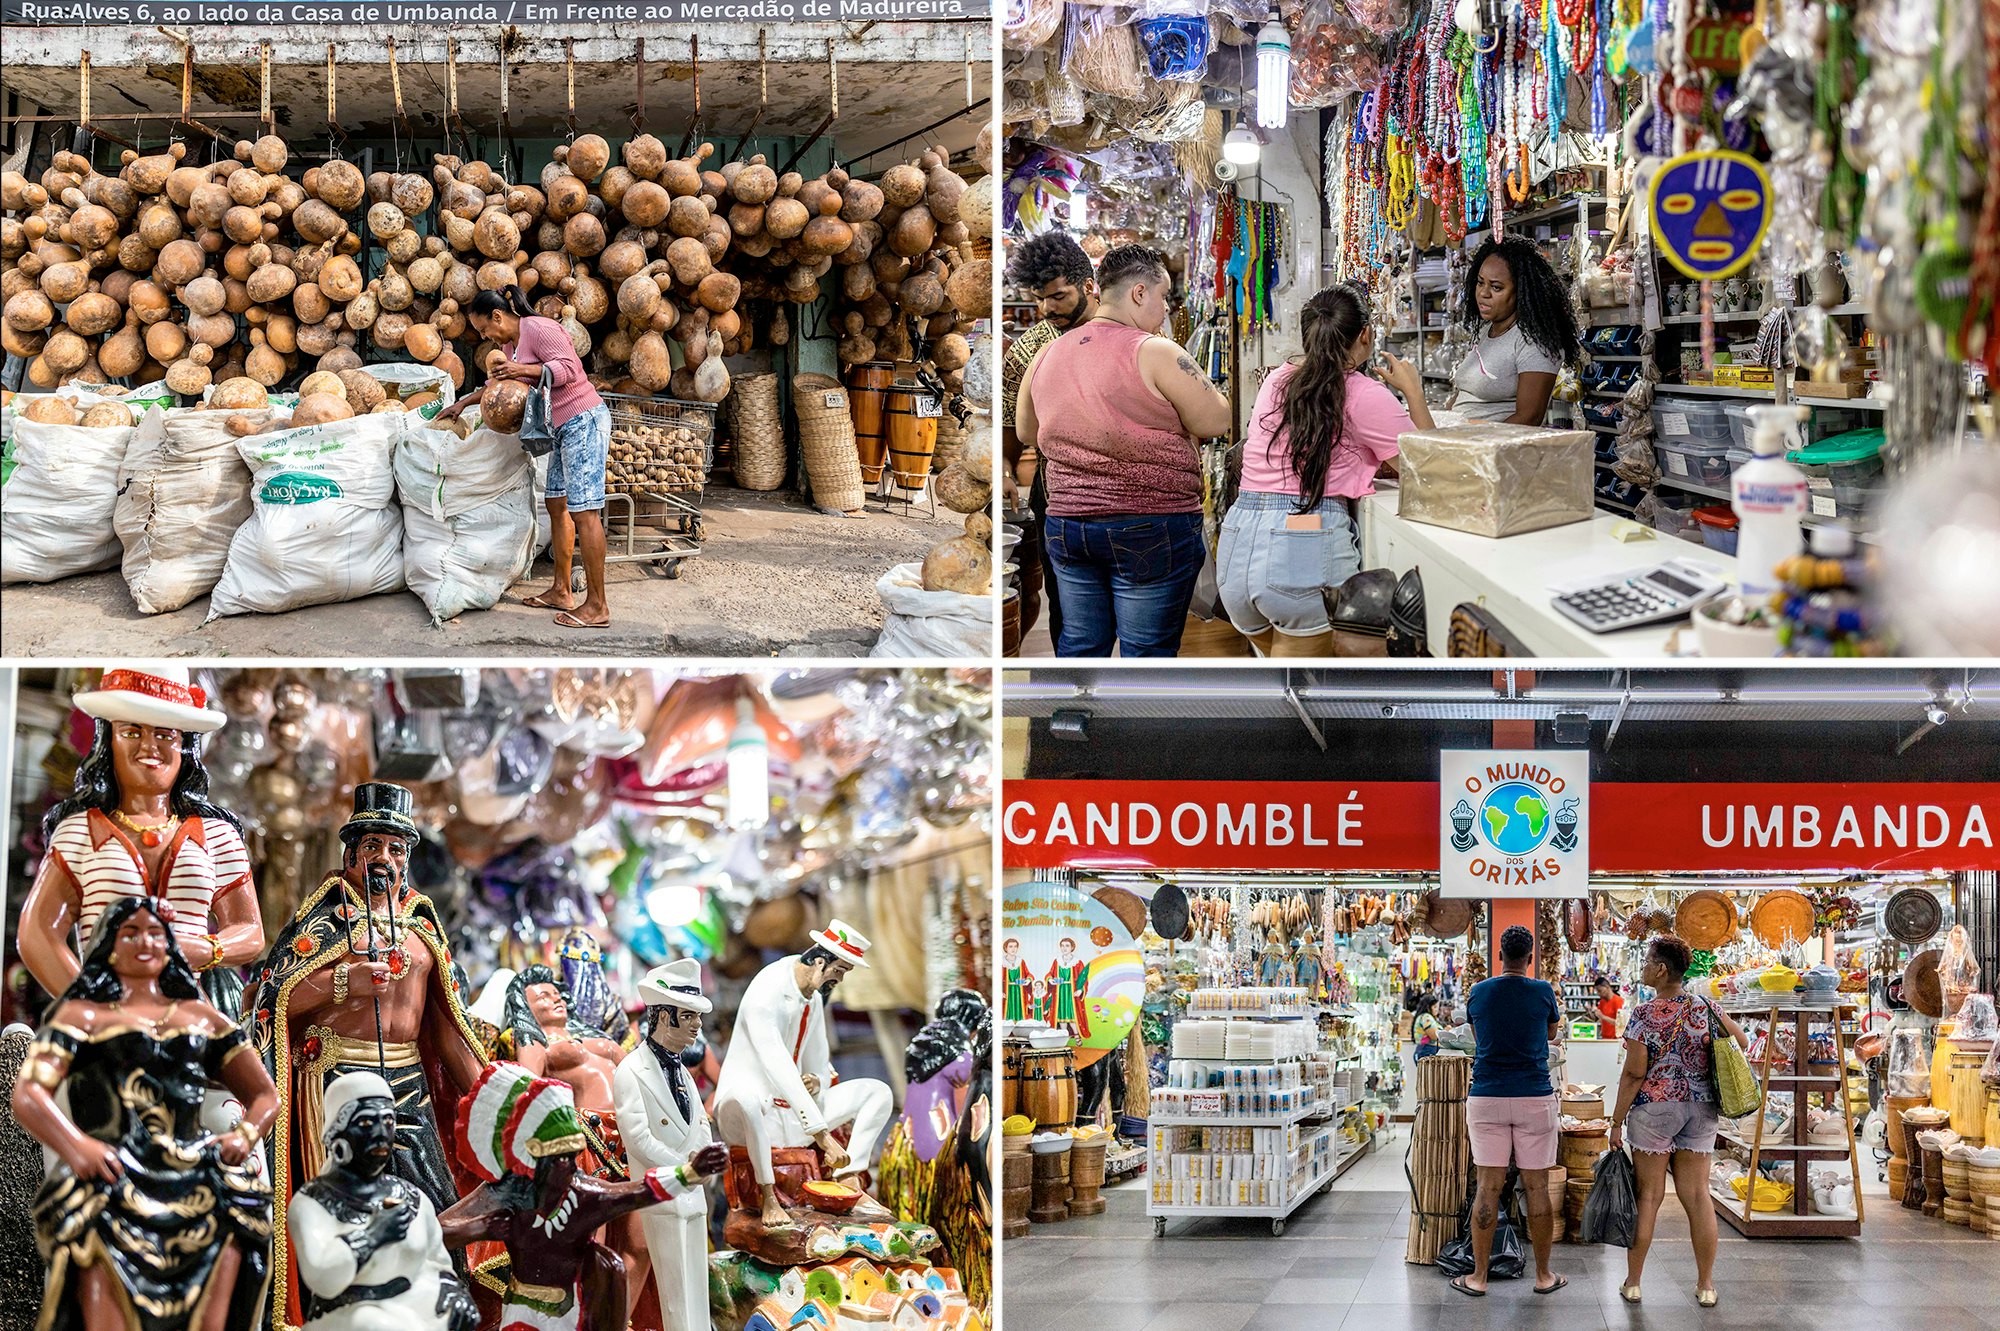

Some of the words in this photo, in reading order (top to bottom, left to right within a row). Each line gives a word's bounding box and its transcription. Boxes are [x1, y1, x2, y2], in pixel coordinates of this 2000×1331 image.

[21, 2, 130, 20] Rua:Alves
[136, 4, 156, 23] 6,
[162, 8, 191, 21] ao
[198, 4, 249, 21] lado
[255, 4, 284, 21] da
[291, 5, 344, 21] Casa
[351, 4, 380, 21] de
[387, 4, 498, 21] Umbanda
[525, 4, 558, 20] Em
[566, 3, 638, 20] Frente
[644, 5, 673, 19] ao
[680, 1, 795, 19] Mercadão
[802, 0, 832, 16] de
[840, 0, 963, 15] Madureira
[1465, 776, 1482, 794] O
[1486, 762, 1566, 794] MUNDO
[1003, 790, 1364, 847] CANDOMBLÉ
[1701, 804, 1993, 849] UMBANDA
[1469, 857, 1561, 886] ORIXÁS
[1003, 899, 1029, 912] Salve
[1031, 897, 1049, 909] São
[1017, 914, 1054, 928] Damião
